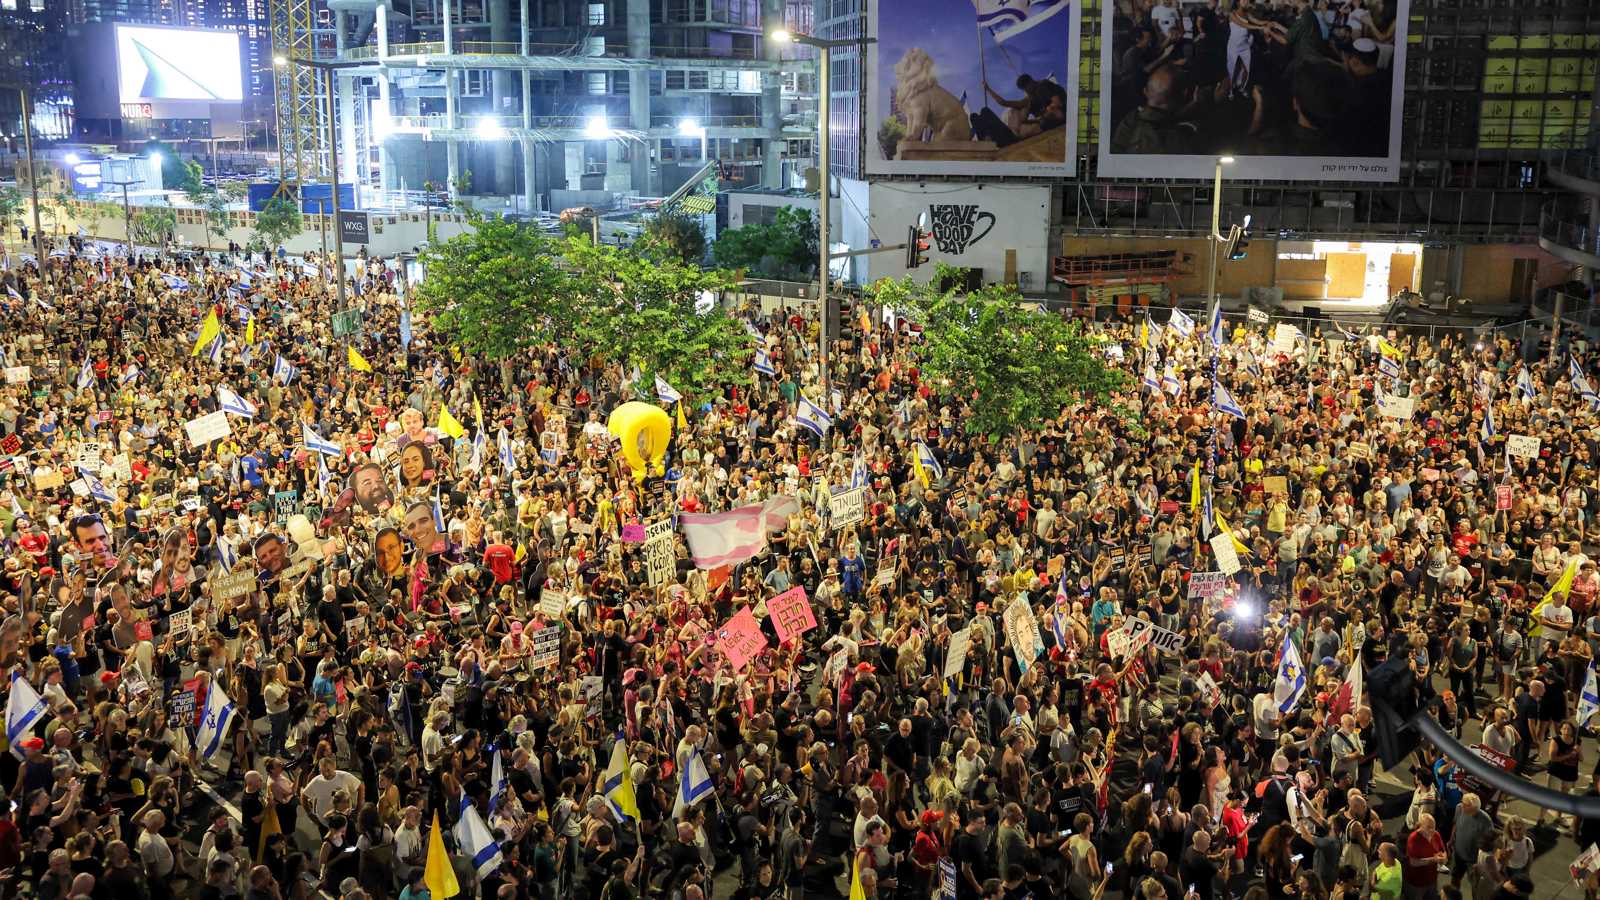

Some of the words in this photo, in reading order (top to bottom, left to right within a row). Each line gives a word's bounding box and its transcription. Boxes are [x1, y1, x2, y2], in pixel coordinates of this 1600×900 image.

[344, 221, 363, 231] WXG
[950, 216, 959, 227] A
[932, 222, 973, 242] GOOD
[936, 240, 969, 255] DAY
[212, 574, 235, 589] NEVER
[230, 583, 249, 596] NOW
